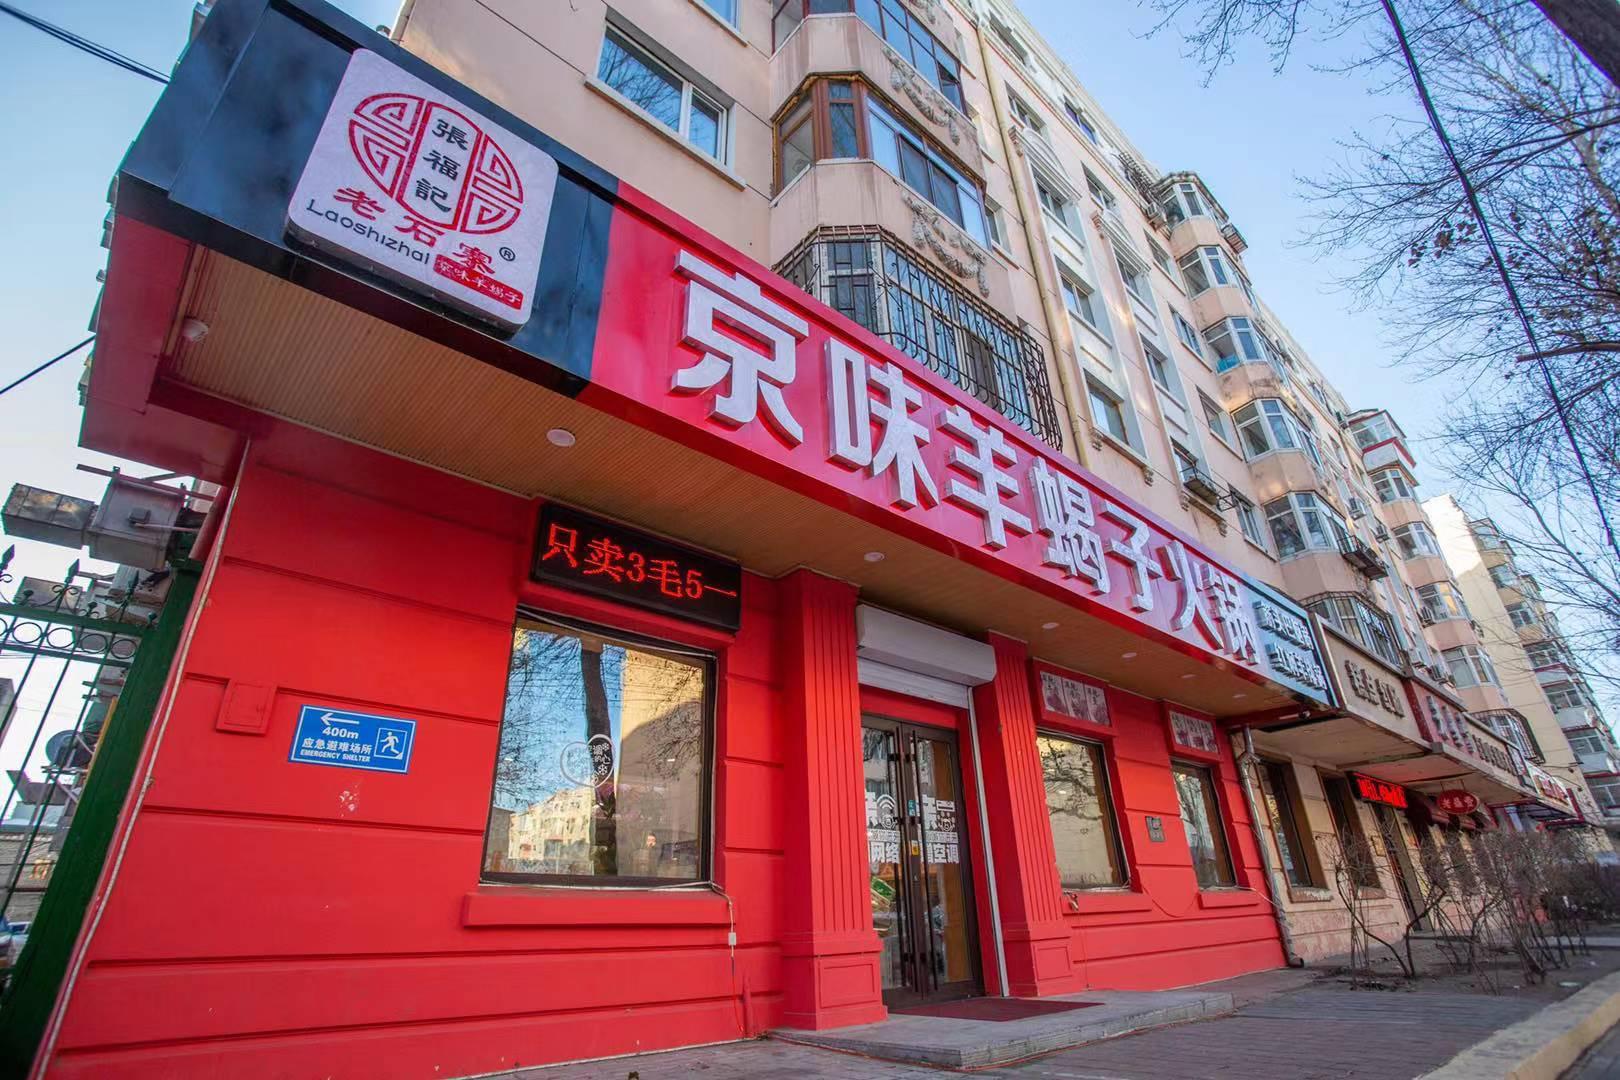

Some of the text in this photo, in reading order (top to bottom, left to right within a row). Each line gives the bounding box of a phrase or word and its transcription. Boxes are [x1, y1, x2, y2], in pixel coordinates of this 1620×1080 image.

[306, 198, 431, 265] Laoshizhai
[670, 248, 1262, 667] 京味羊蝎子火锅
[322, 726, 359, 740] 400m
[301, 737, 373, 755] 应急避难场所
[300, 748, 371, 763] EMERGENCY SHELTER
